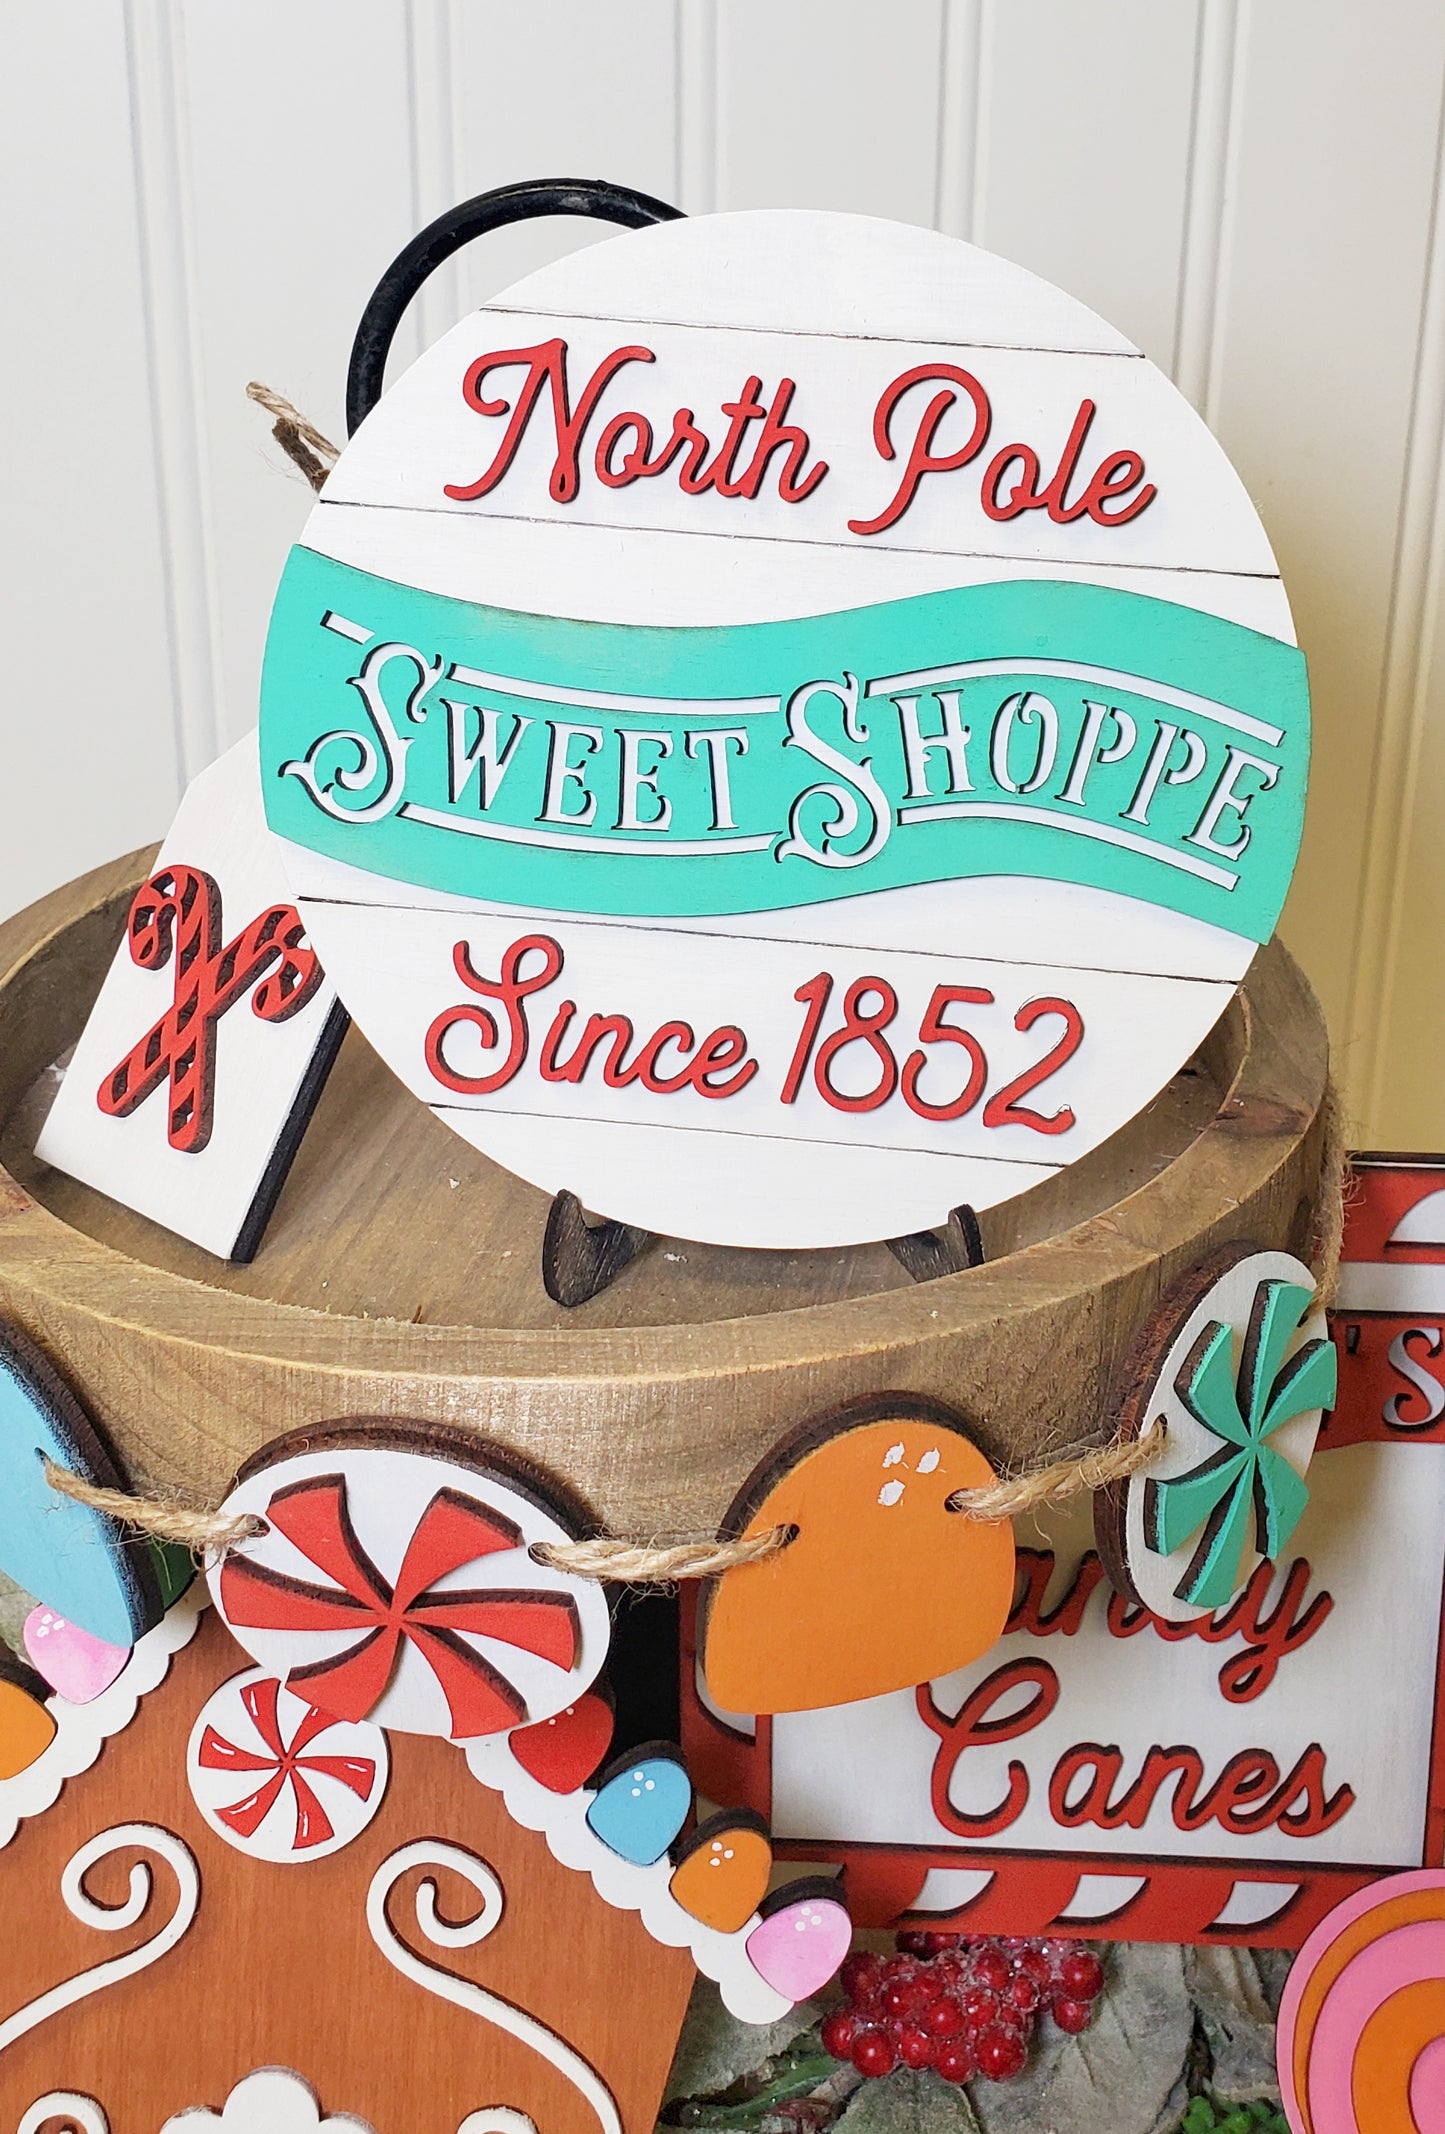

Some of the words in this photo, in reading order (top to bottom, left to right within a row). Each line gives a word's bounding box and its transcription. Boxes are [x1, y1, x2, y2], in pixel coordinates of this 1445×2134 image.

[444, 337, 830, 505] North
[847, 362, 1158, 536] Pole
[279, 638, 754, 828] SWEET
[773, 670, 1284, 870] SHOPPE
[424, 933, 759, 1098] Since
[780, 971, 1085, 1135] 1852
[914, 1656, 1357, 1838] Canes
